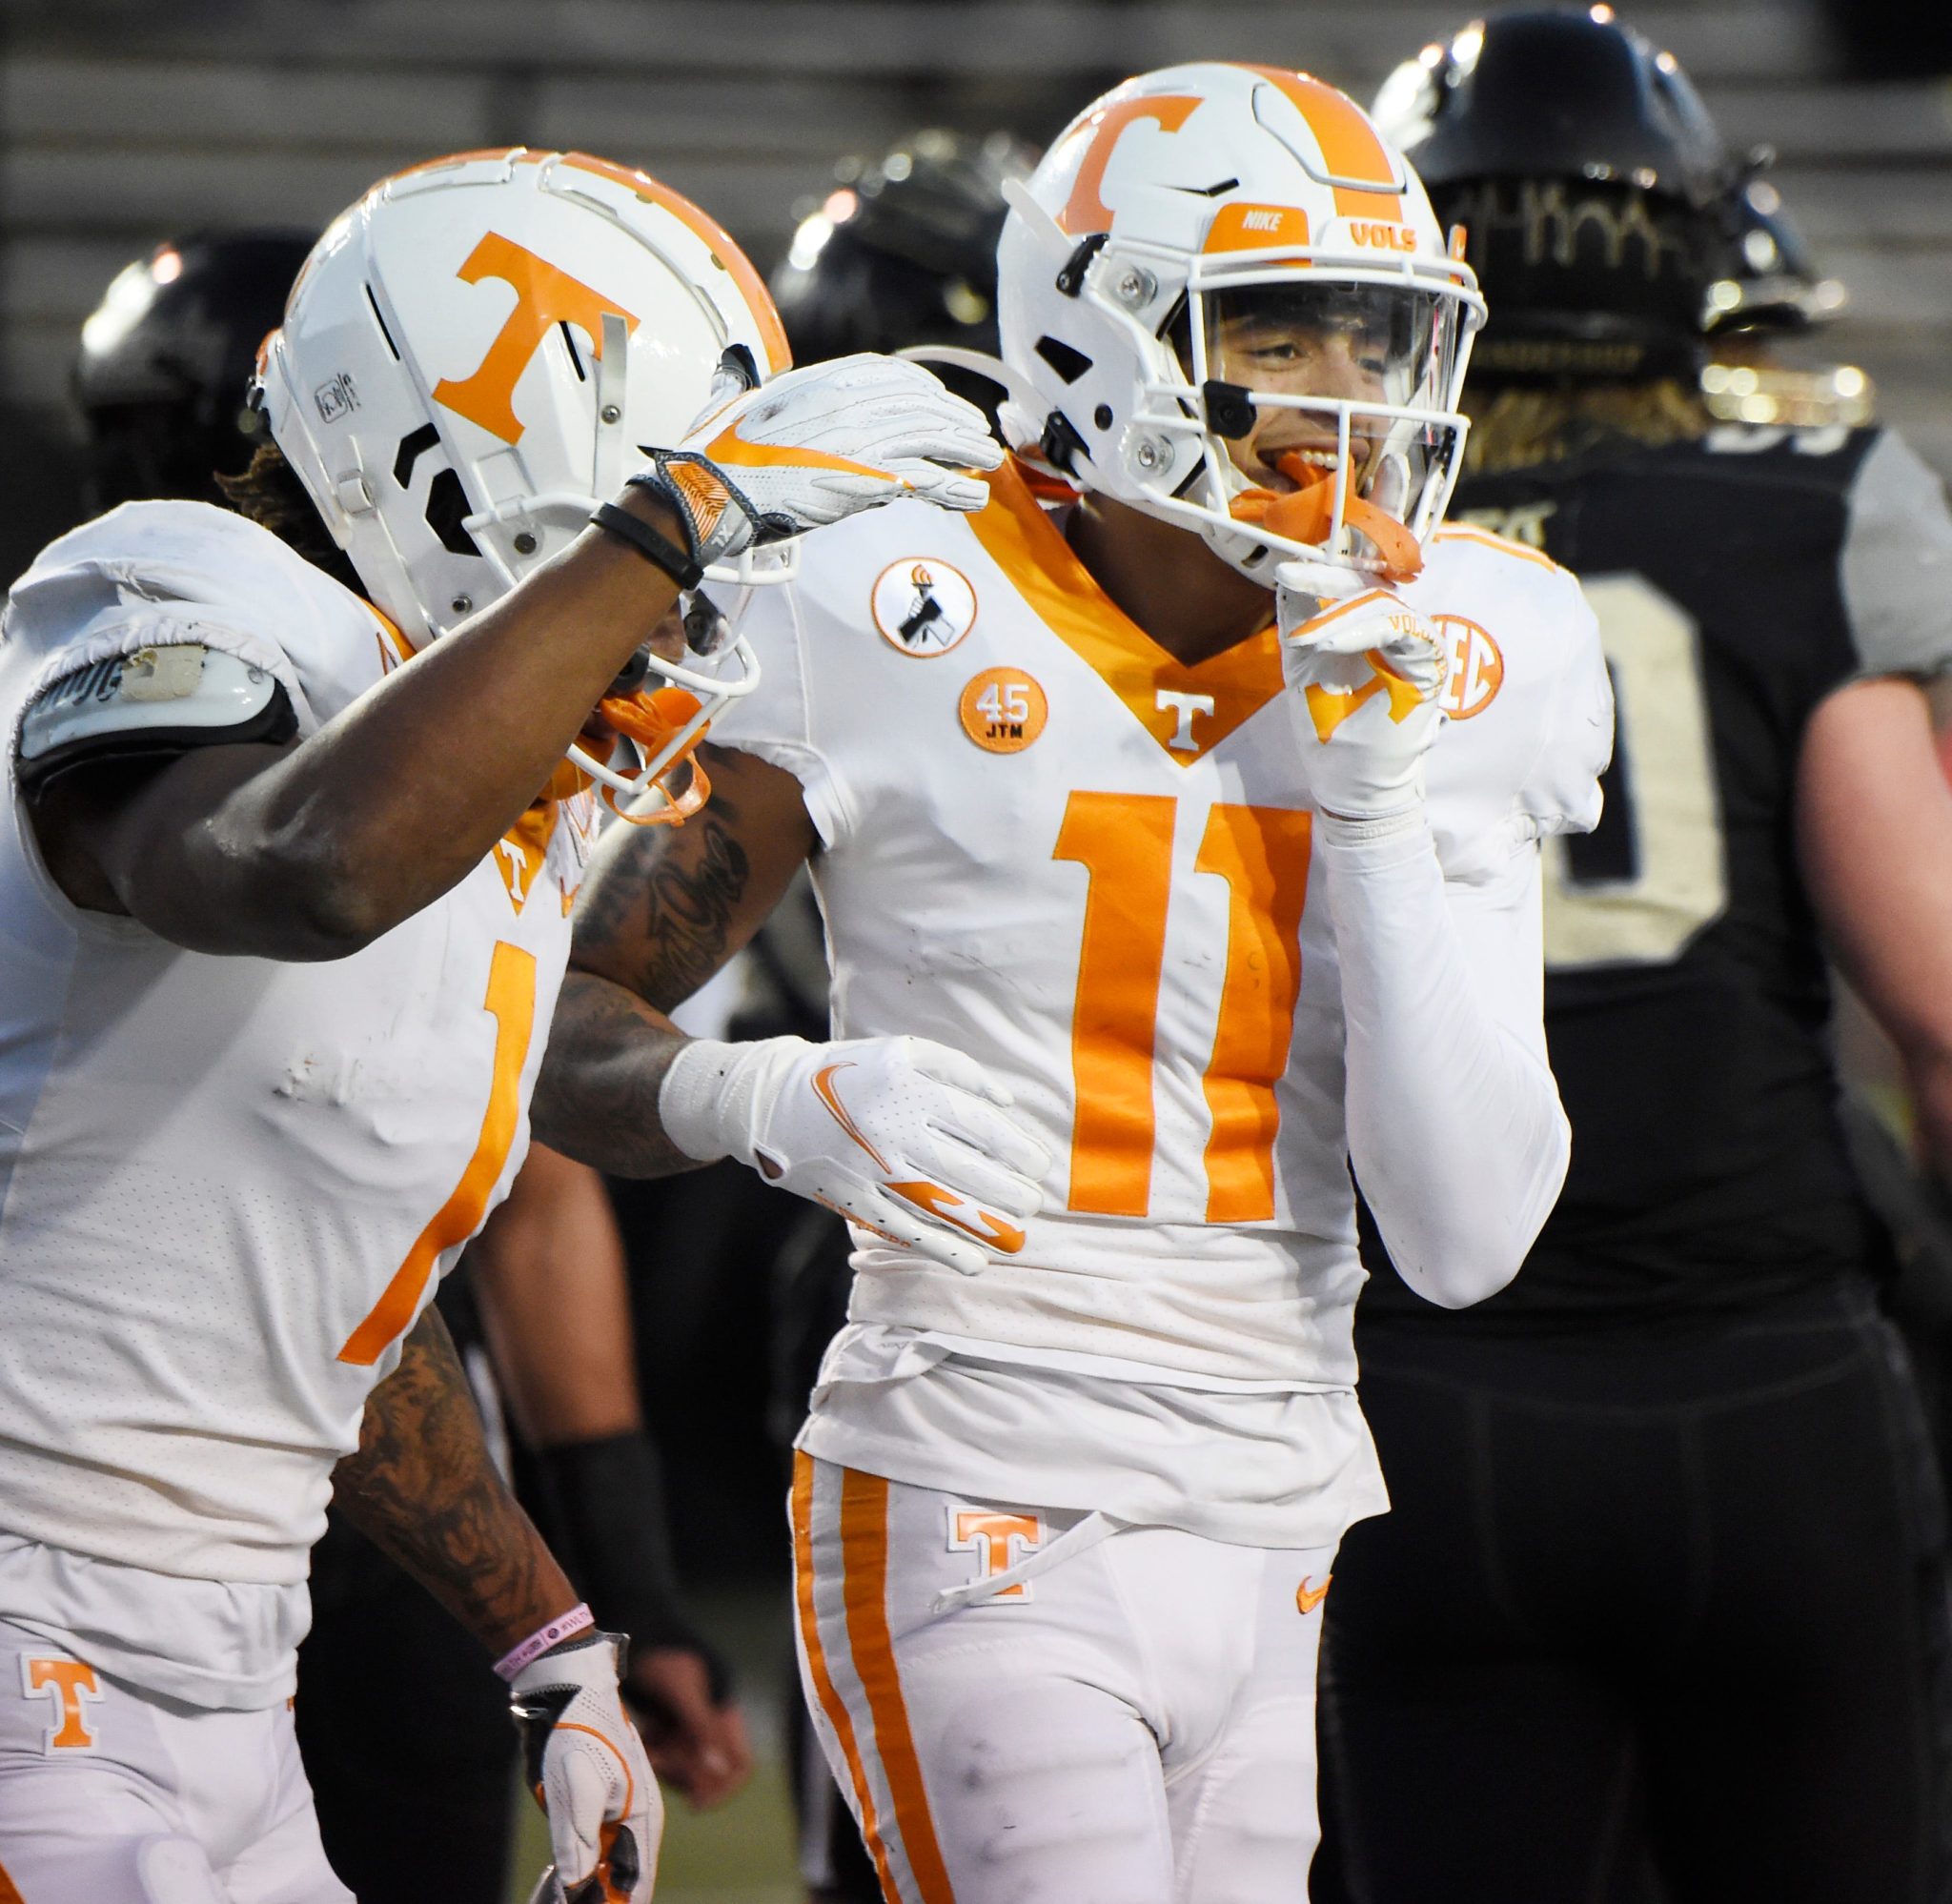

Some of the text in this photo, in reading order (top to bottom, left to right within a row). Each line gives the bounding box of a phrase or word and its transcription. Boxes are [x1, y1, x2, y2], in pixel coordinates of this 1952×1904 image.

[1242, 210, 1283, 232] NIKE
[1350, 222, 1416, 253] VOLS
[432, 230, 640, 445] T
[710, 524, 734, 548] XL
[1434, 619, 1495, 711] EC
[976, 683, 1029, 722] 45
[986, 724, 1023, 739] JTM
[1156, 688, 1215, 751] T
[499, 839, 527, 901] T
[1052, 790, 1312, 1223] 11
[336, 941, 537, 1366] 1
[953, 1509, 1043, 1599] T
[29, 1657, 103, 1750] T
